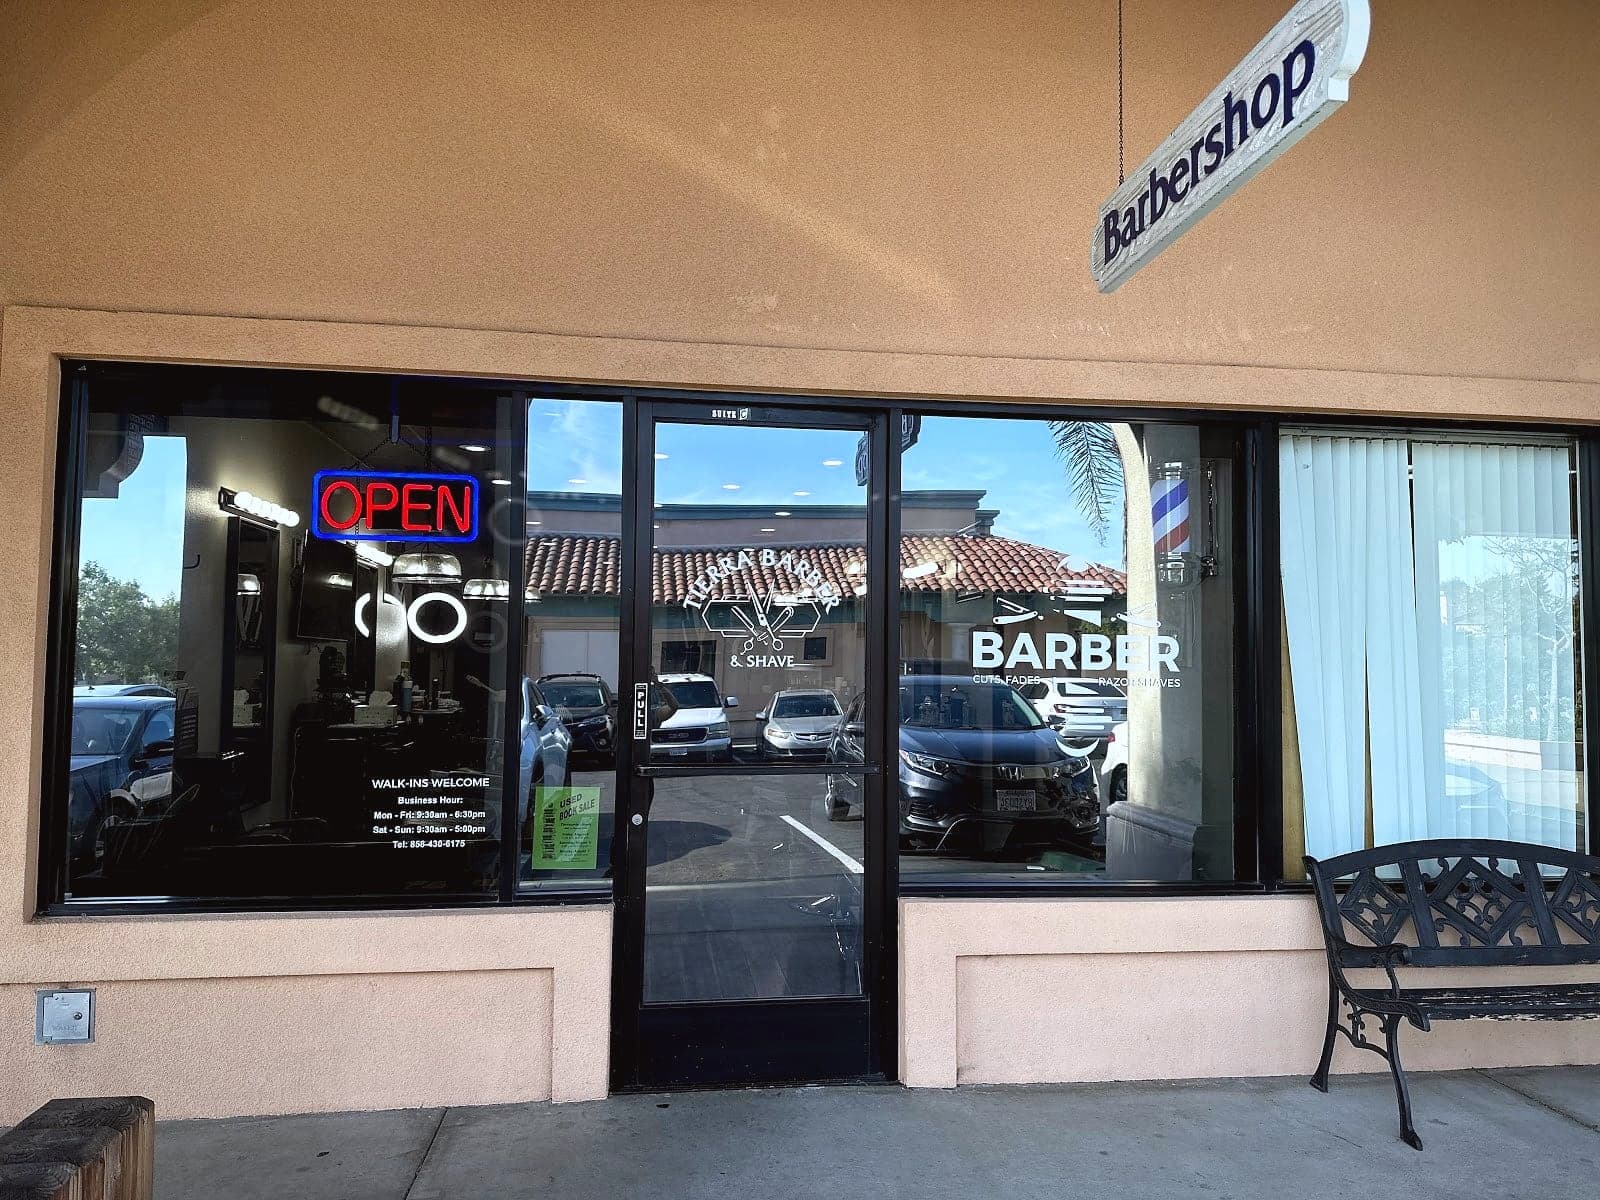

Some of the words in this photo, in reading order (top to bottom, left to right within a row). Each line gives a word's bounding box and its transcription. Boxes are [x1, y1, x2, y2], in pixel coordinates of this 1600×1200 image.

[1103, 39, 1316, 265] Barbershop
[712, 409, 737, 419] SUITE
[321, 481, 471, 533] OPEN
[683, 550, 753, 610] TIERRA
[760, 549, 840, 615] BARBER
[972, 631, 1180, 672] BARBER
[730, 655, 743, 667] &
[746, 655, 795, 668] SHAVE
[1005, 675, 1041, 685] FADES
[637, 691, 645, 727] PULL
[371, 779, 429, 789] WALK-INS
[431, 778, 490, 788] WELCOME
[397, 796, 438, 805] Business
[439, 795, 464, 804] Hour:
[560, 793, 583, 808] USED
[373, 811, 393, 820] Mon
[399, 811, 415, 819] Fri:
[416, 811, 448, 819] 9:30am
[559, 807, 578, 821] BOOK
[578, 798, 595, 813] SALE
[372, 826, 388, 834] Sat
[394, 825, 415, 834] Sun:
[416, 825, 448, 834] 9:30am
[454, 825, 486, 834] 5:00pm
[392, 841, 408, 849] Tel:
